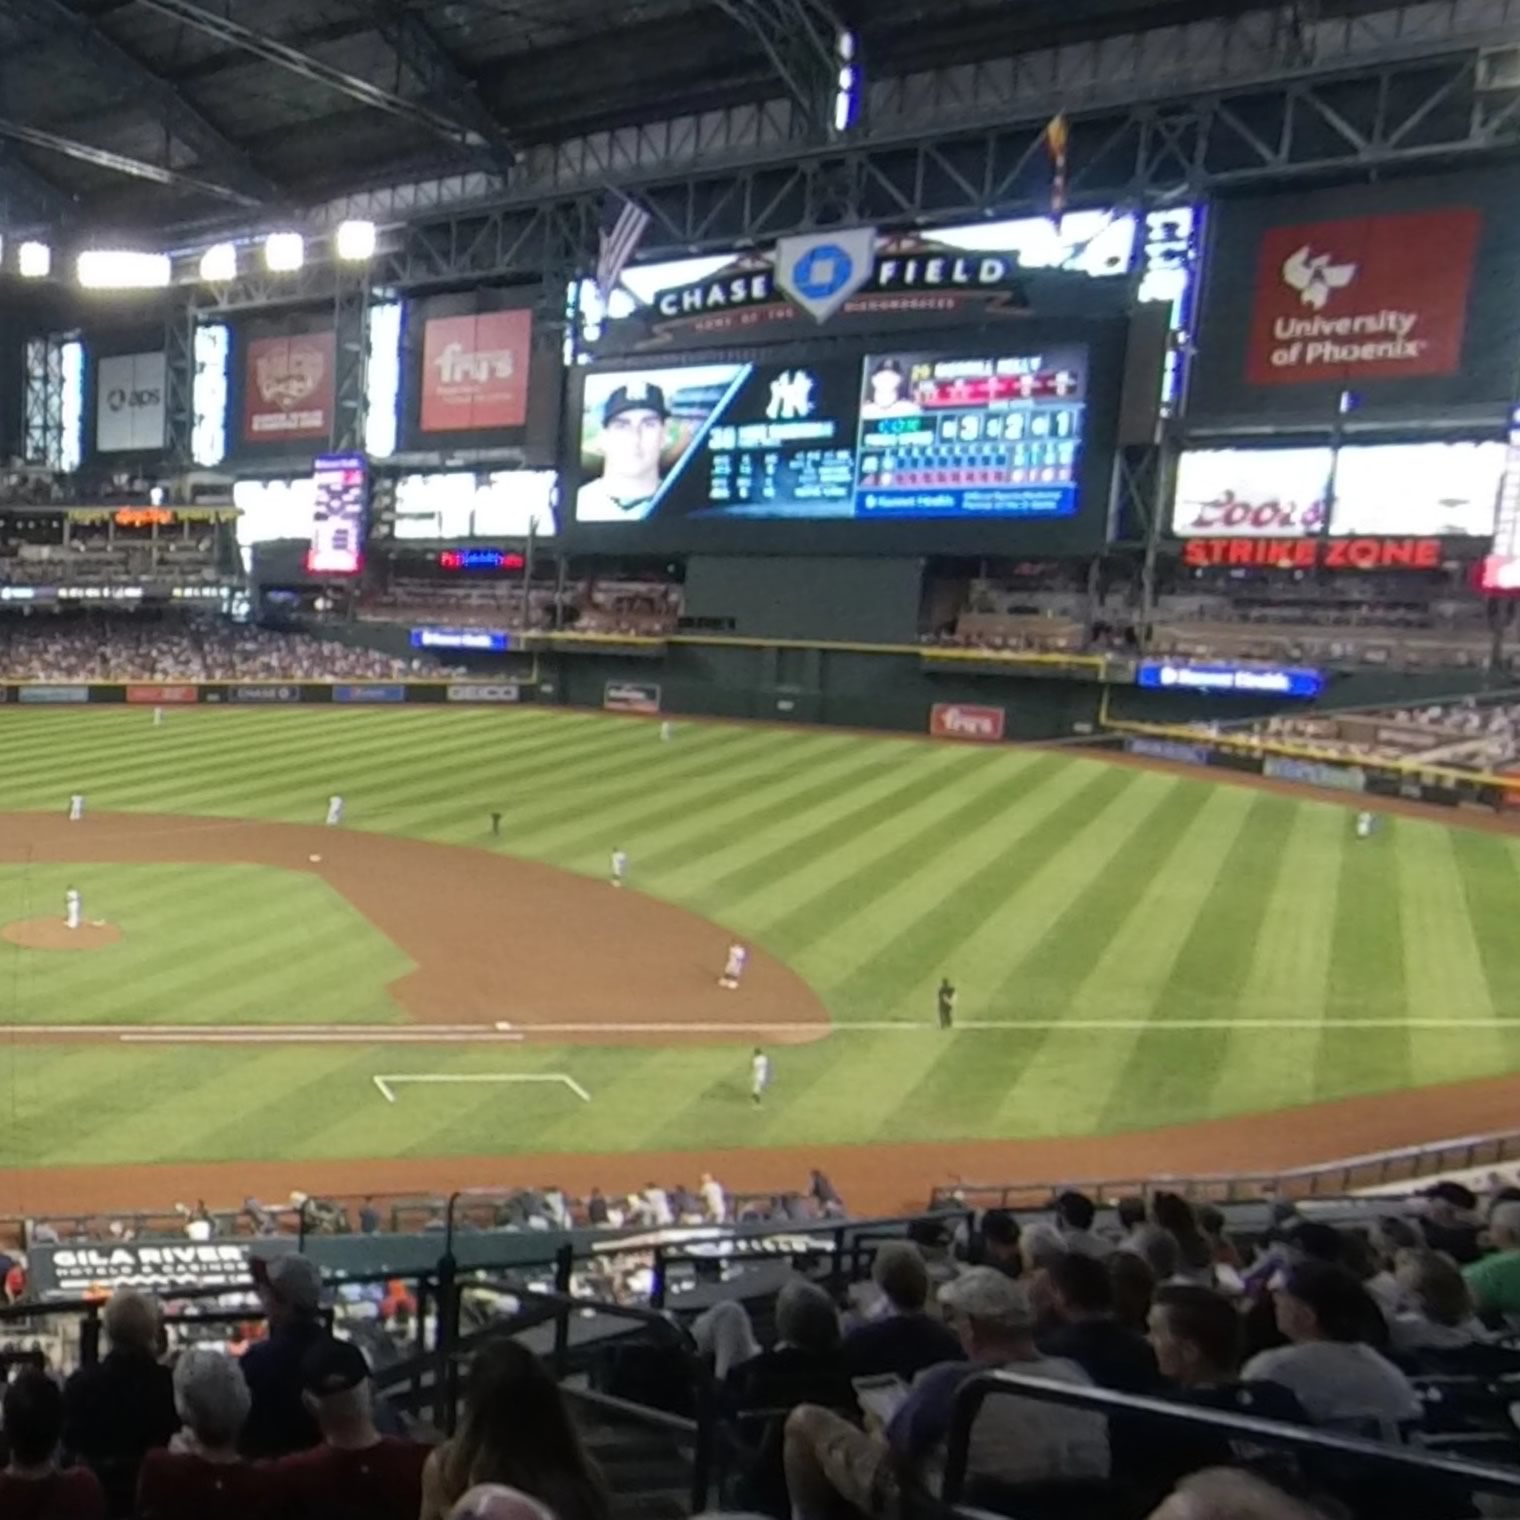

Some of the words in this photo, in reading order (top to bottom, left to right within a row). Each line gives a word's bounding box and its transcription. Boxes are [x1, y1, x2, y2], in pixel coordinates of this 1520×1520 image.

[659, 275, 768, 316] CHASE
[879, 257, 1006, 286] FIELD
[1274, 309, 1417, 339] University
[1270, 343, 1301, 367] of
[1306, 338, 1418, 364] Phoenix
[128, 388, 161, 409] aps
[960, 415, 979, 441] 3
[1005, 412, 1024, 440] 2
[1056, 410, 1070, 437] 1
[1185, 538, 1318, 567] STRIKE
[1324, 539, 1441, 567] ZONE
[53, 1249, 136, 1267] GILA
[138, 1245, 244, 1264] RIVER
